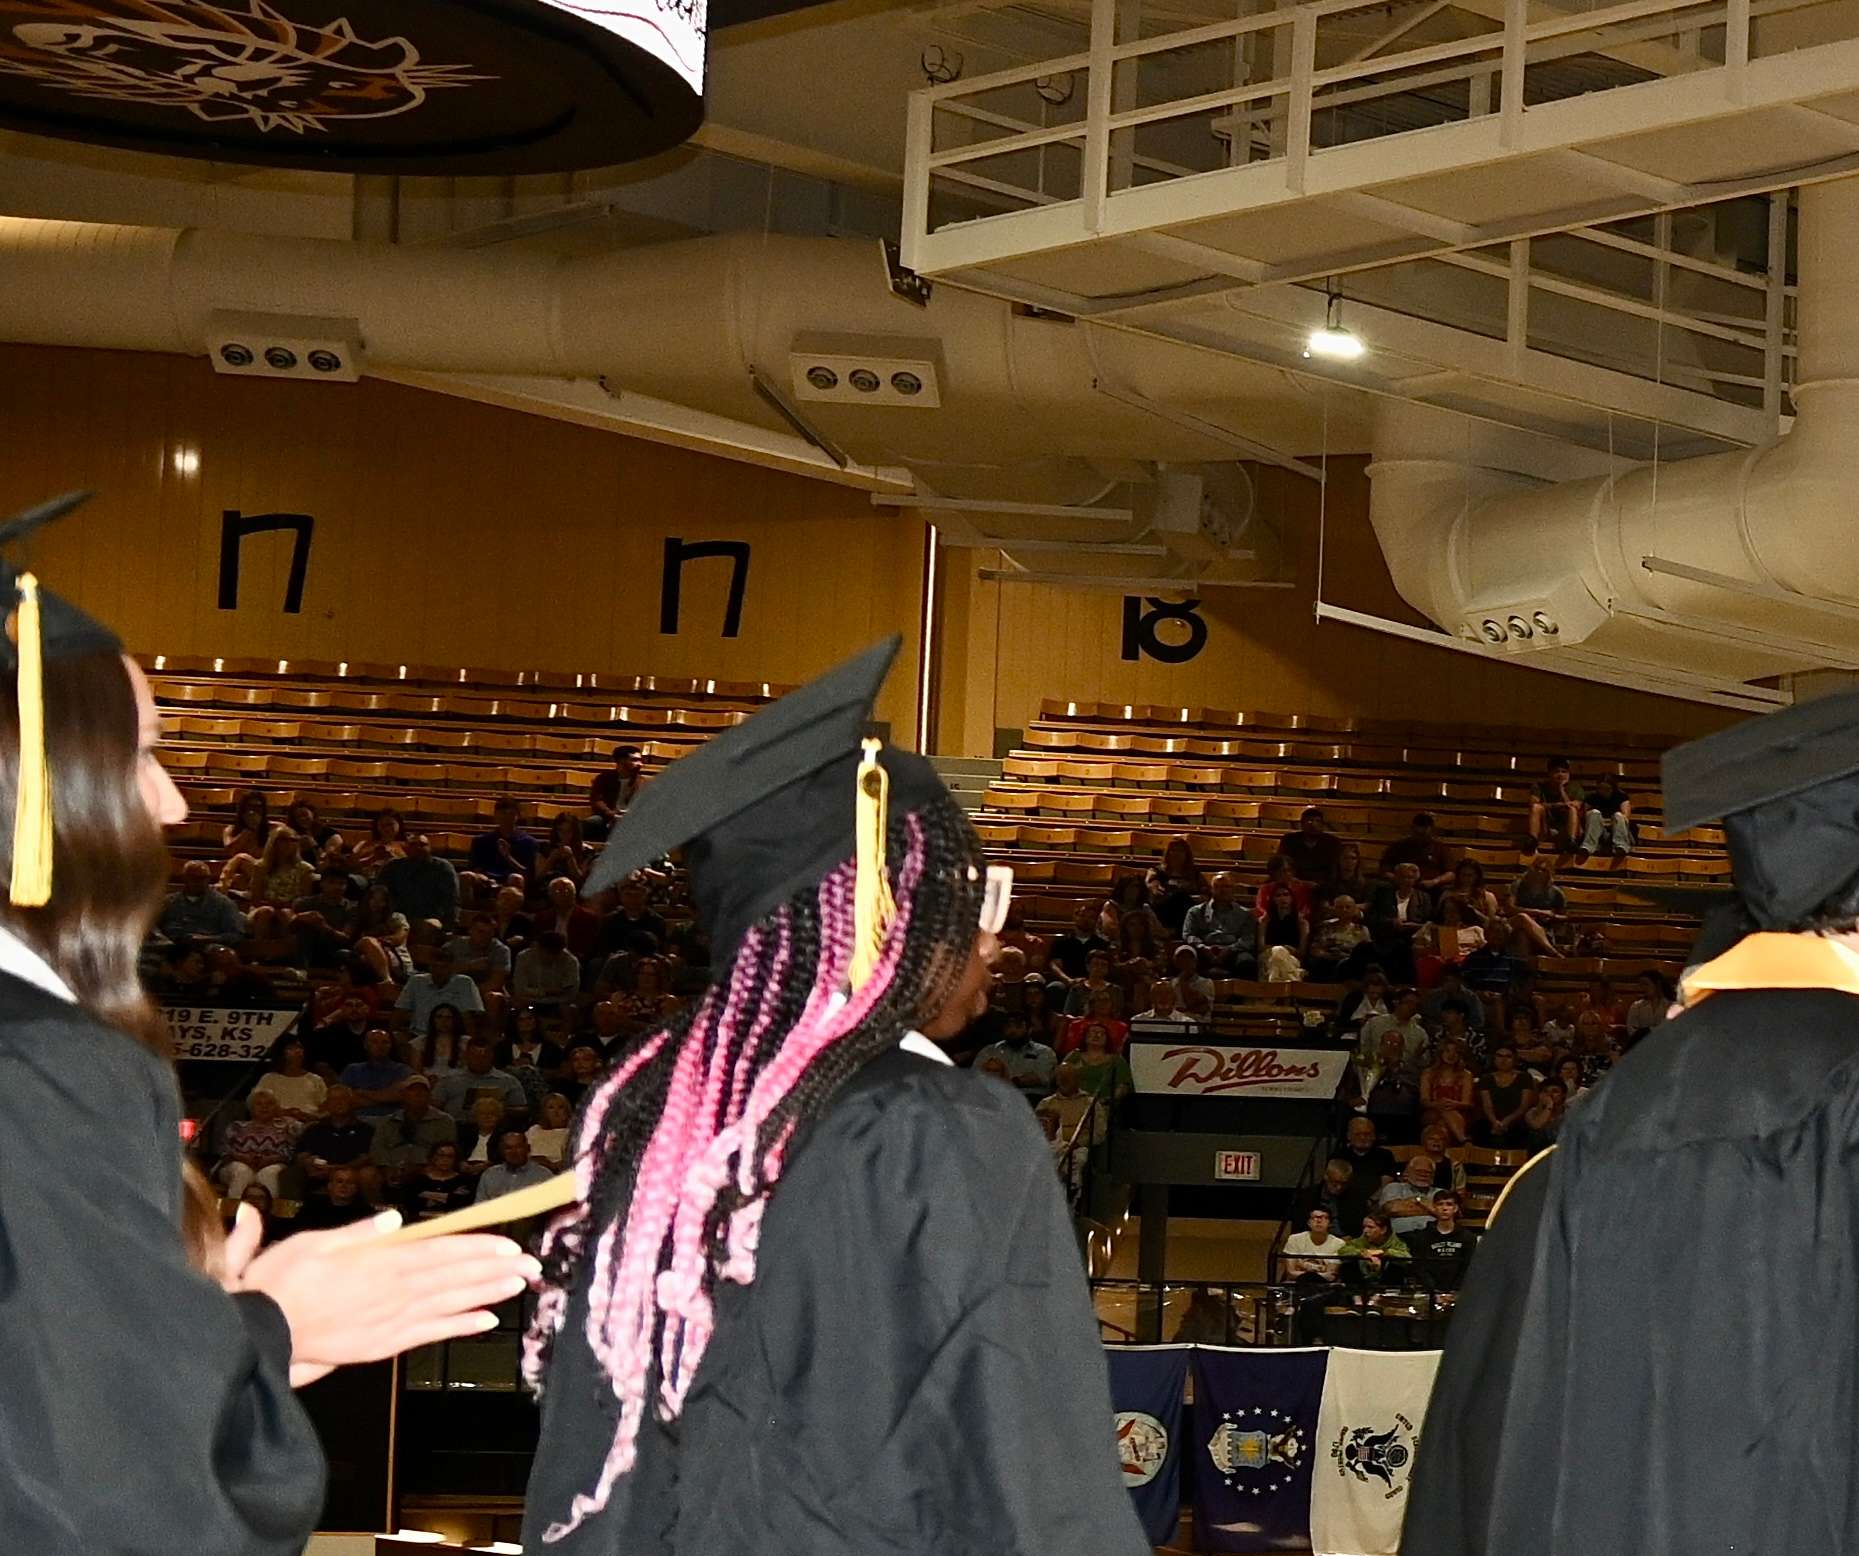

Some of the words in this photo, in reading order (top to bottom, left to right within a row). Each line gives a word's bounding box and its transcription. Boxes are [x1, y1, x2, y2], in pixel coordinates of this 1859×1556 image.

[198, 1010, 218, 1024] E.
[228, 1011, 274, 1025] 9TH
[220, 1027, 252, 1041] KS
[1161, 1046, 1320, 1089] Dillons
[1224, 1154, 1253, 1175] EXIT
